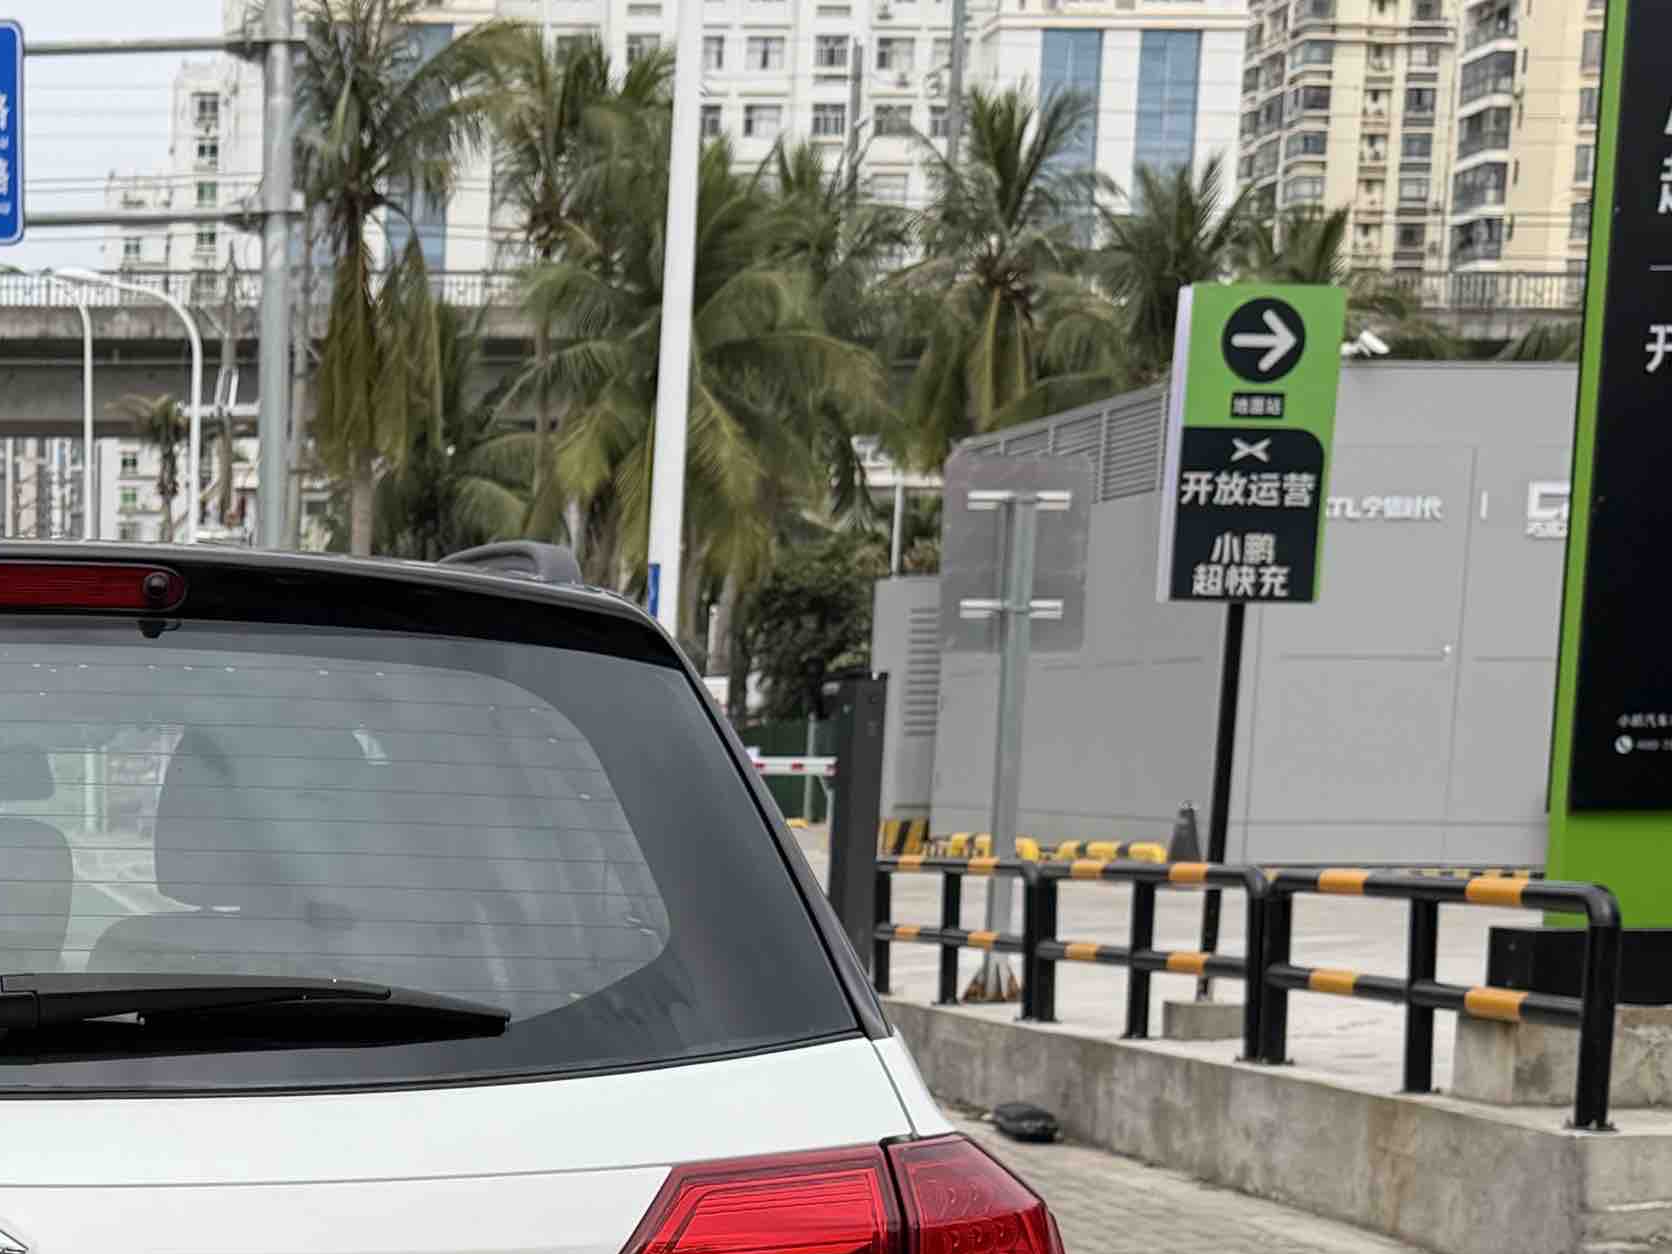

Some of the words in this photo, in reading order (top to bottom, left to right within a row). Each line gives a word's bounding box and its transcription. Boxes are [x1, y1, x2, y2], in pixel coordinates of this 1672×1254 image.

[1180, 471, 1317, 507] 开放运营
[1210, 531, 1275, 565] 小鹏
[1192, 564, 1291, 597] 超快充
